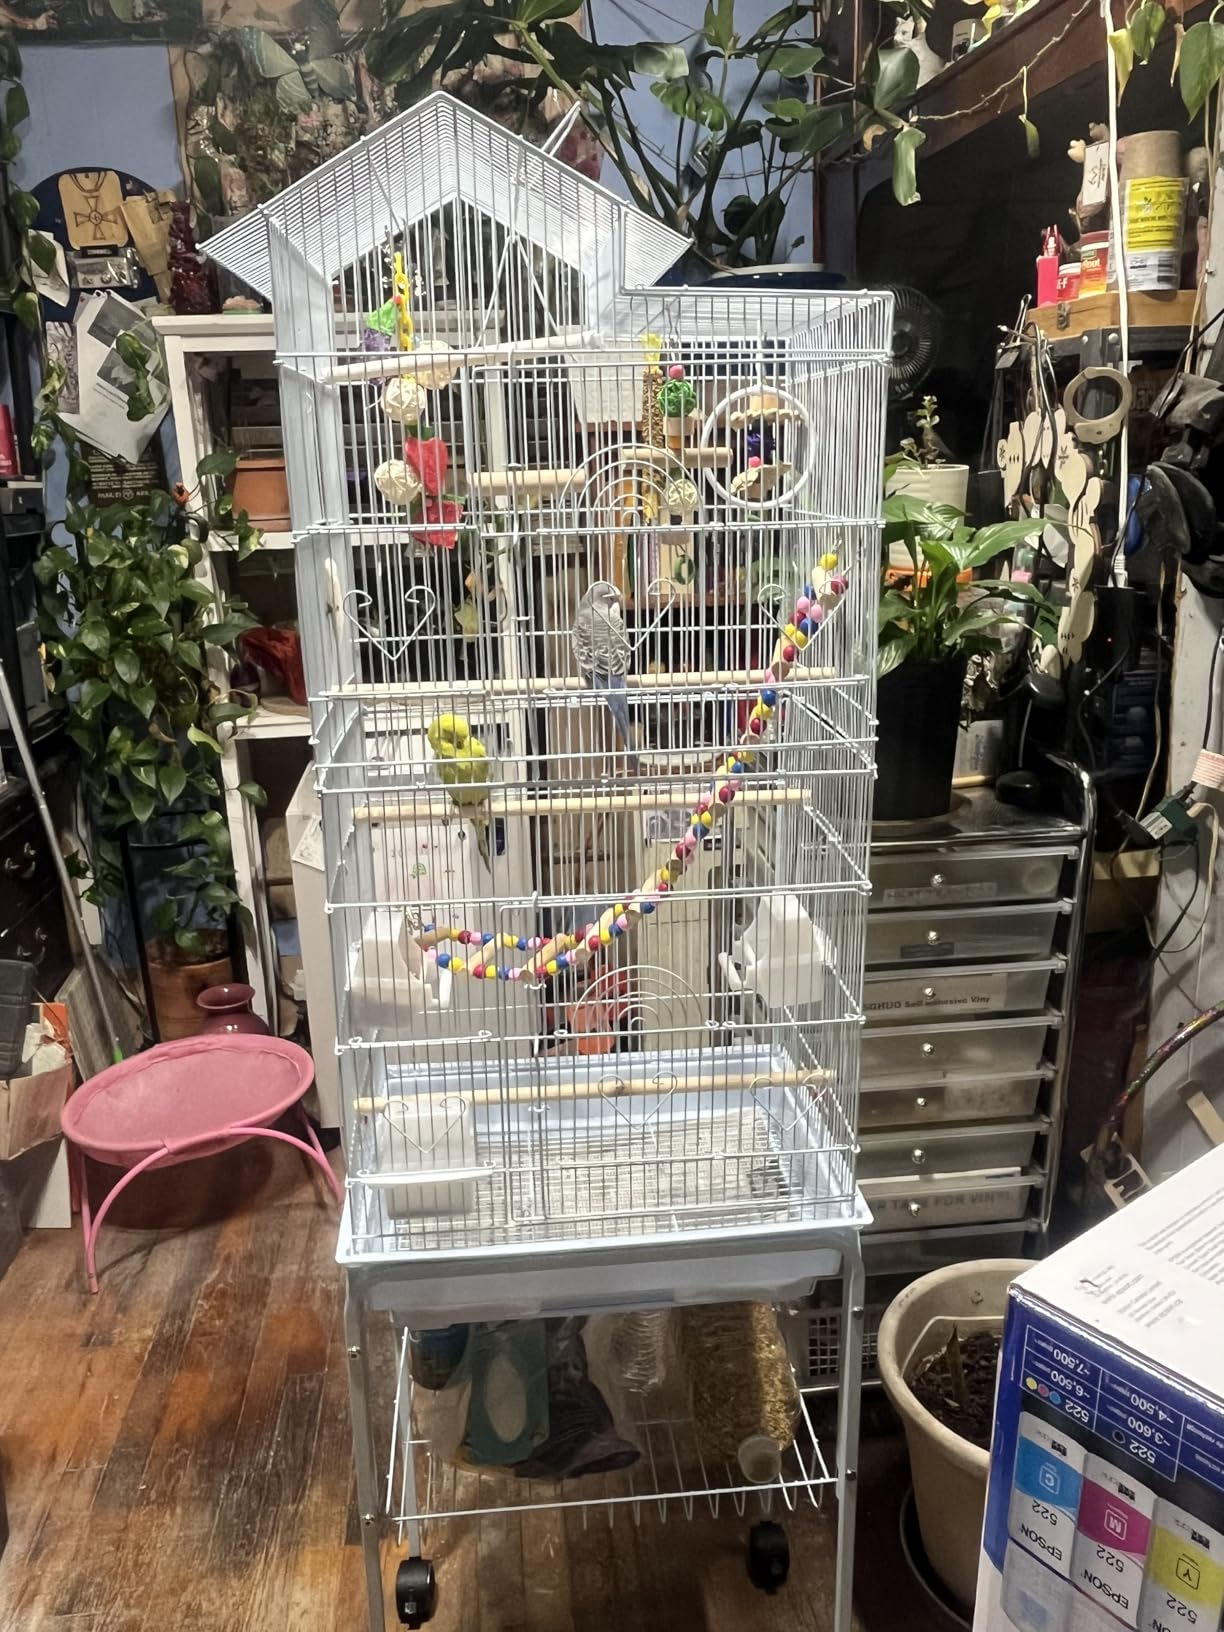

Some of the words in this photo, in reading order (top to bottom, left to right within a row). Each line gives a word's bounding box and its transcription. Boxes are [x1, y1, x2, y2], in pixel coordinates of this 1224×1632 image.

[1064, 1399, 1090, 1423] 522
[1129, 1439, 1156, 1464] 522
[1045, 1473, 1055, 1486] C
[1031, 1500, 1058, 1526] 522
[1108, 1517, 1122, 1534] M
[1020, 1523, 1063, 1561] EPSON
[1096, 1544, 1125, 1573] 522
[1183, 1569, 1193, 1582] Y
[1083, 1569, 1129, 1610] EPSON
[1166, 1592, 1198, 1625] 522
